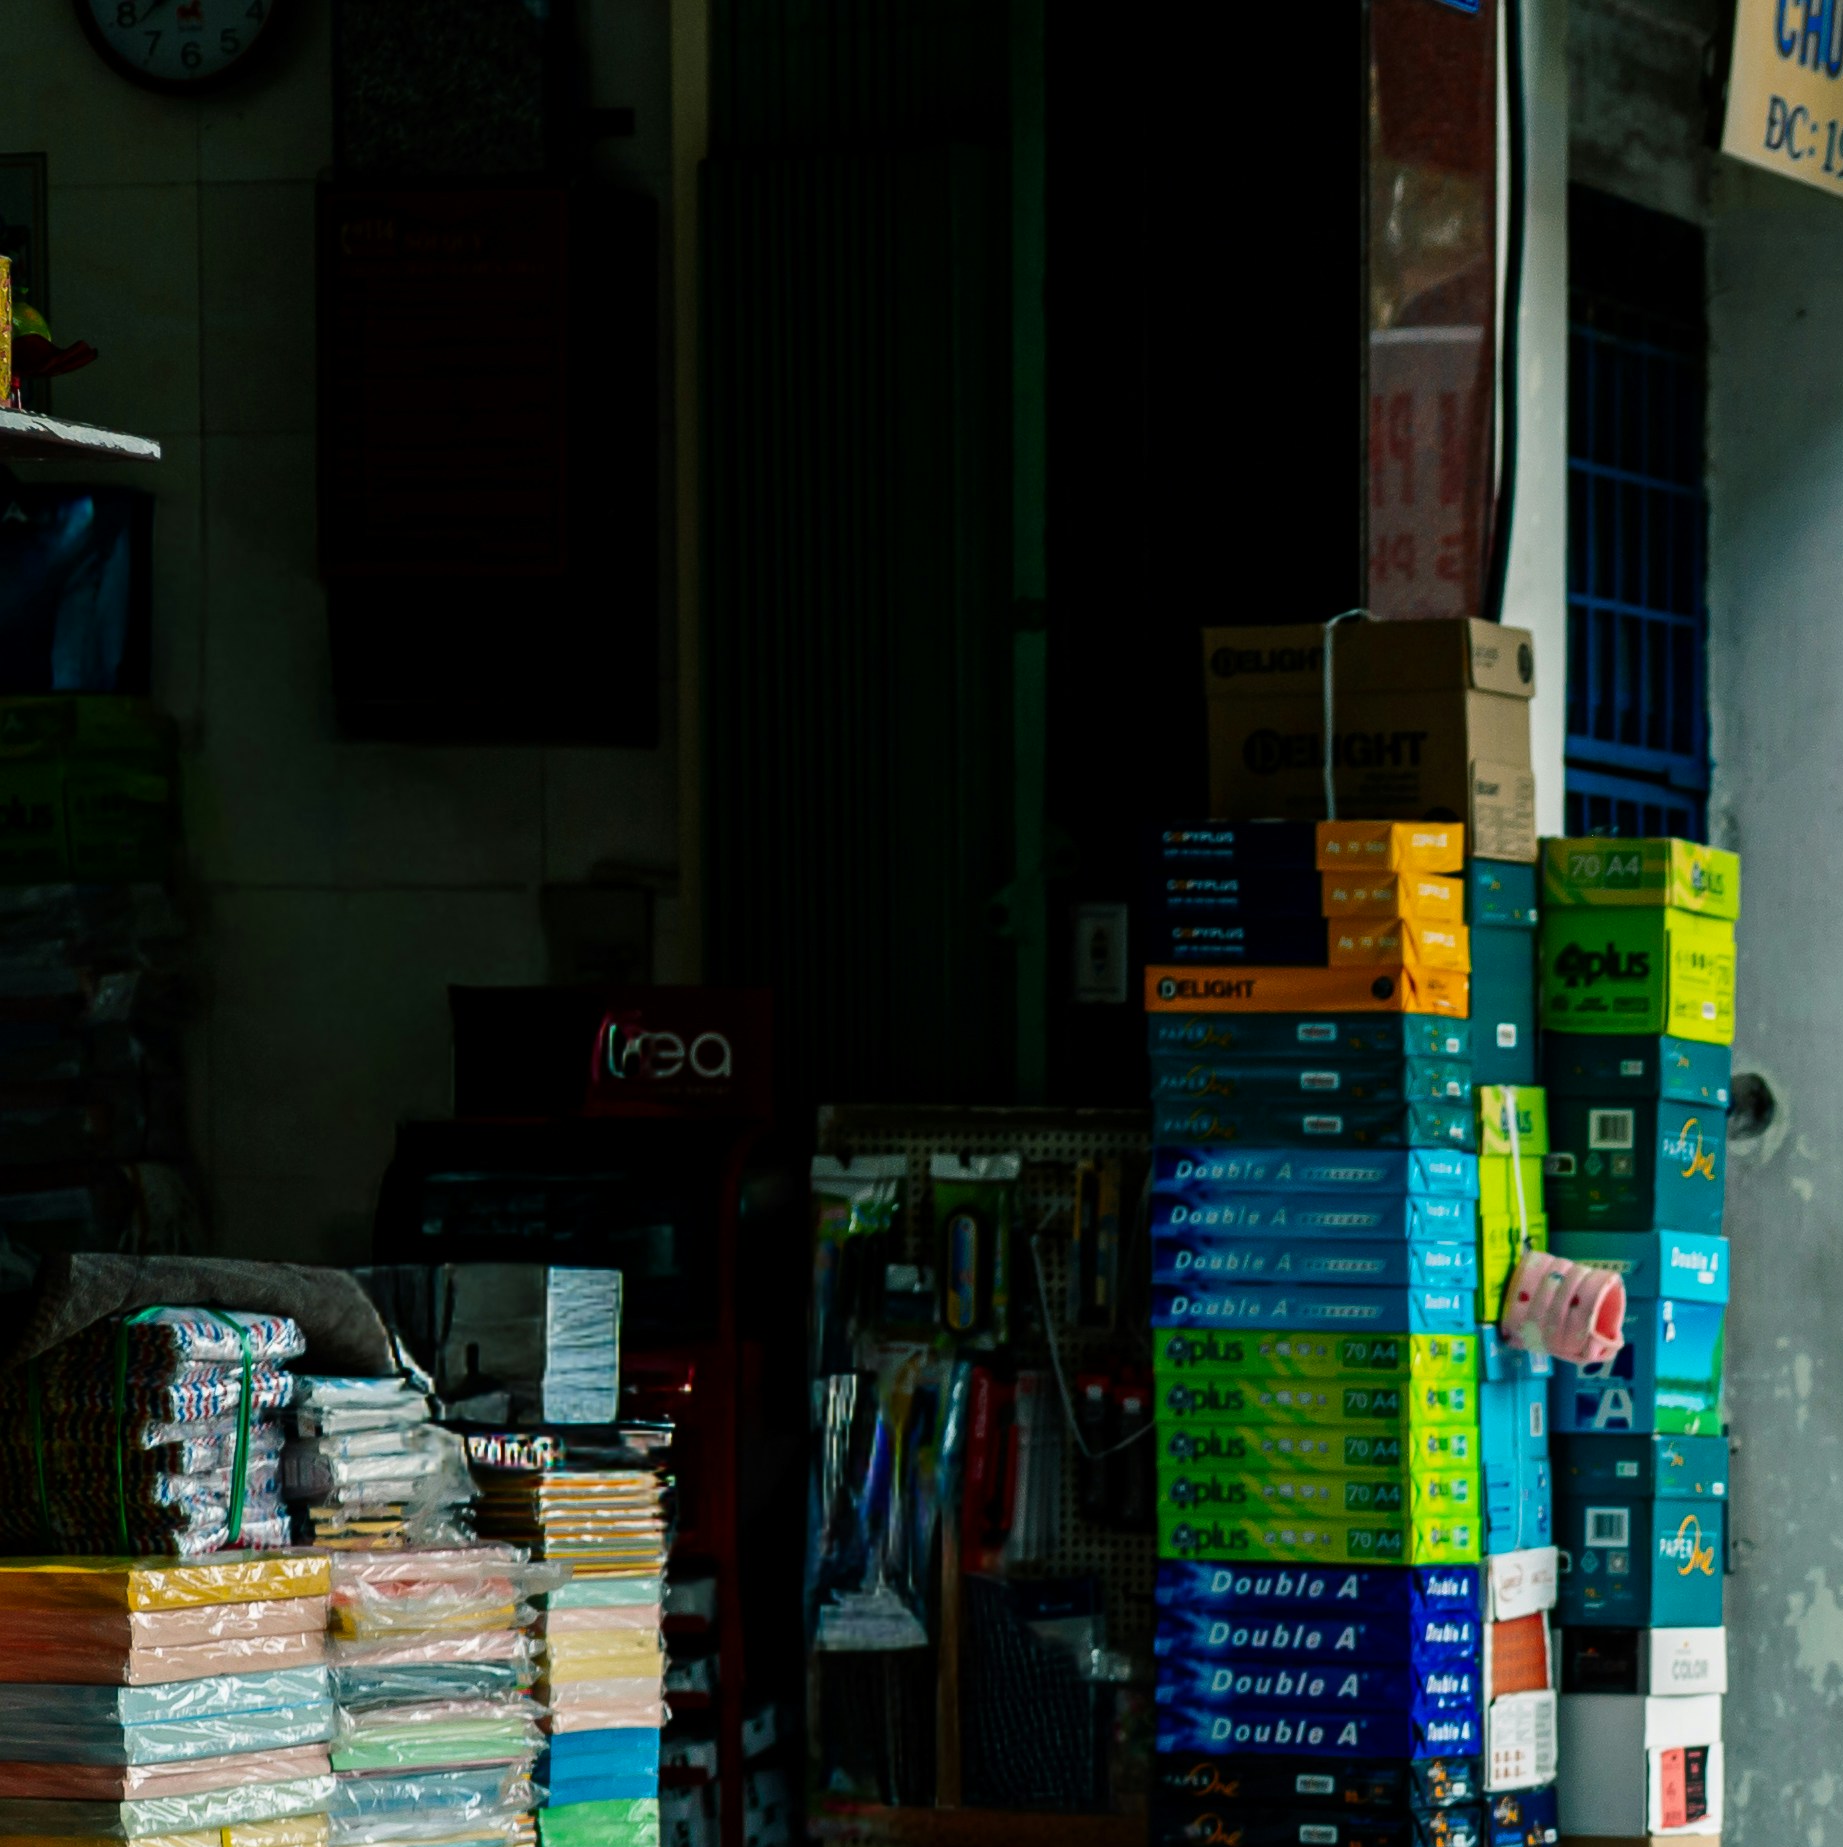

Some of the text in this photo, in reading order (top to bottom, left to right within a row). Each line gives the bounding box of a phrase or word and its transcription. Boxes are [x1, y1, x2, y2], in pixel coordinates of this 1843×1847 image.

[116, 1, 137, 29] 8
[245, 0, 264, 26] 4
[144, 30, 162, 57] 7
[220, 28, 240, 55] 5
[181, 41, 202, 69] 6
[1764, 95, 1819, 161] ĐC:
[1605, 853, 1641, 877] A4
[1157, 976, 1256, 1000] DELIGHT
[1175, 1158, 1266, 1180] Double
[1275, 1162, 1292, 1181] A
[1169, 1204, 1288, 1227] Double A
[1174, 1248, 1292, 1273] Double A
[1170, 1295, 1288, 1318] Double A
[1345, 1342, 1398, 1360] 70 A4
[1346, 1393, 1400, 1410] 70 A4
[1346, 1439, 1400, 1458] 70 A4
[1347, 1485, 1401, 1503] 70 A4
[1349, 1532, 1402, 1550] 70 A4
[1211, 1569, 1325, 1598] Double
[1208, 1621, 1323, 1650] Double
[1211, 1669, 1325, 1699] Double
[1211, 1716, 1325, 1747] Double
